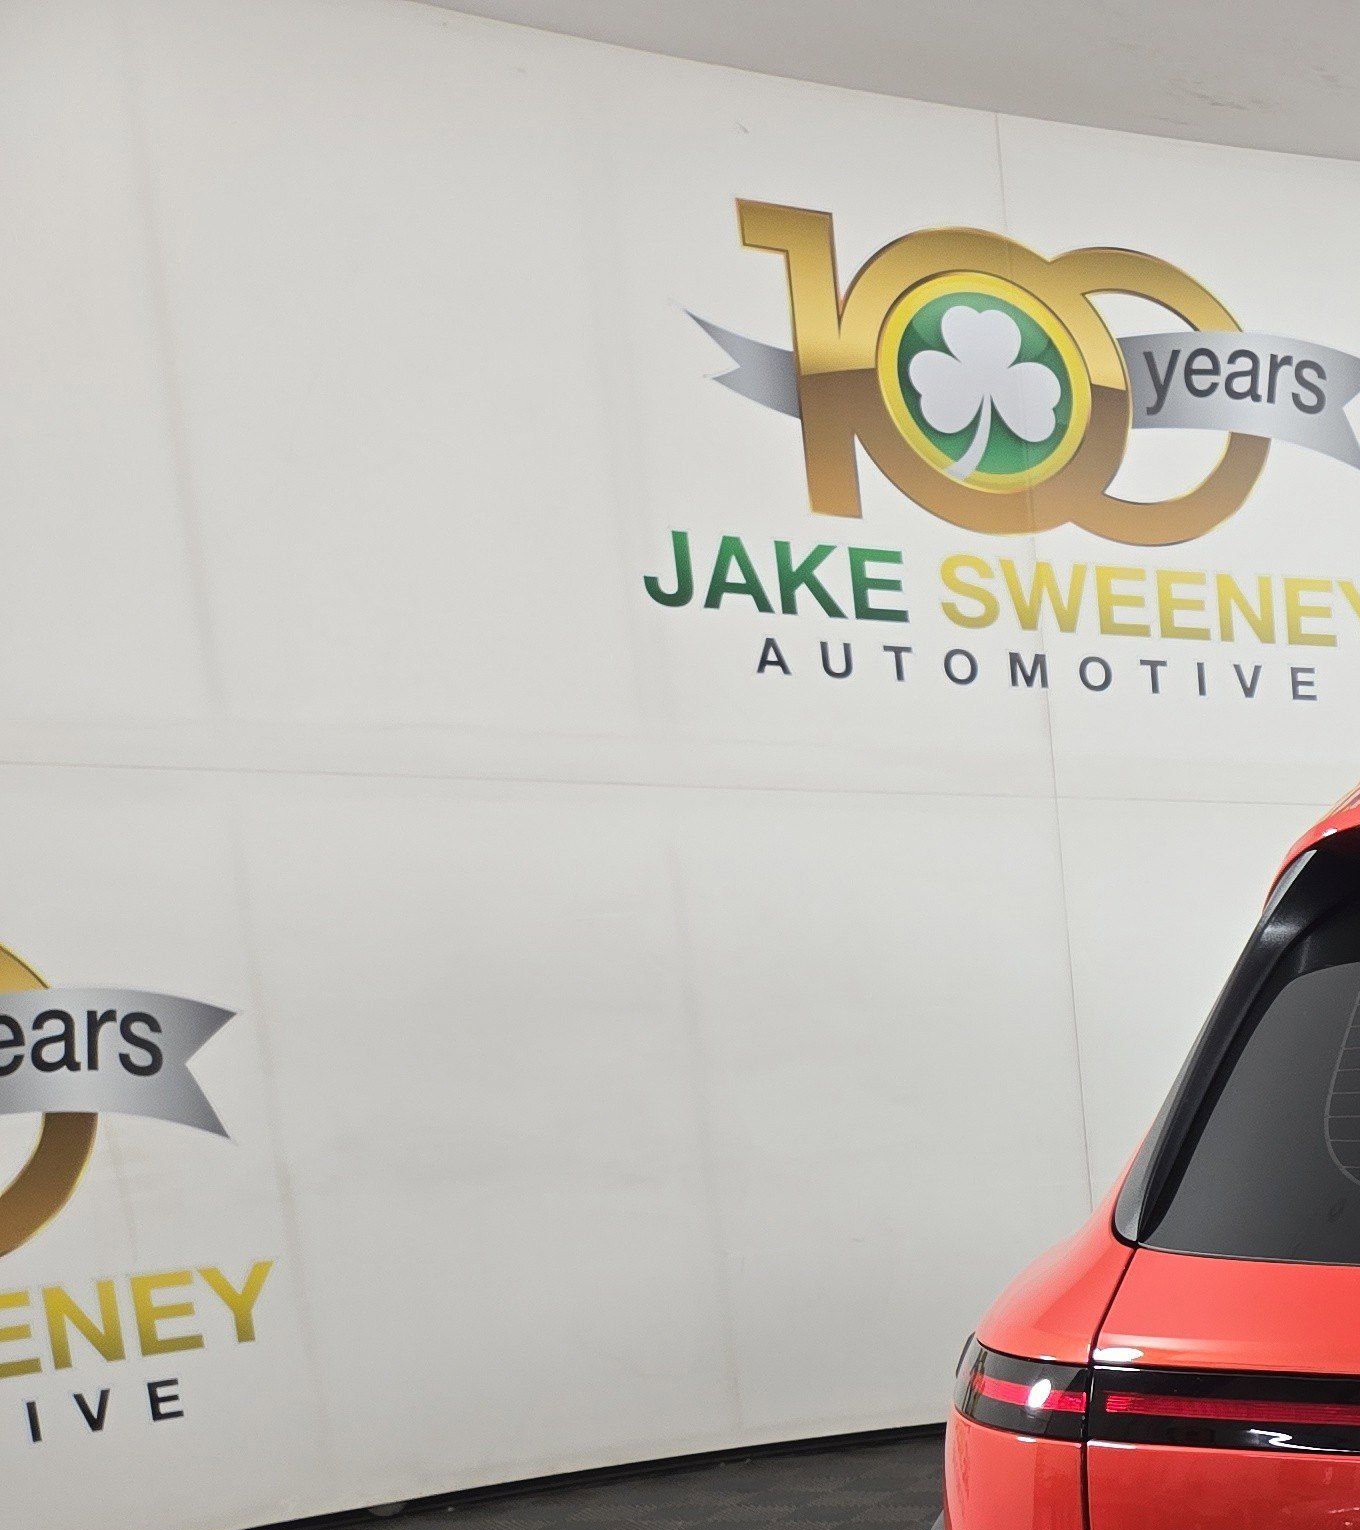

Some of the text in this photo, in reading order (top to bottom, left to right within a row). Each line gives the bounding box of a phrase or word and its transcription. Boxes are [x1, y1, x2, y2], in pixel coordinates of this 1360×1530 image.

[735, 198, 1271, 546] 100
[1143, 346, 1328, 416] years
[643, 529, 910, 624] JAKE
[756, 637, 1319, 702] AUTOMOTIVE
